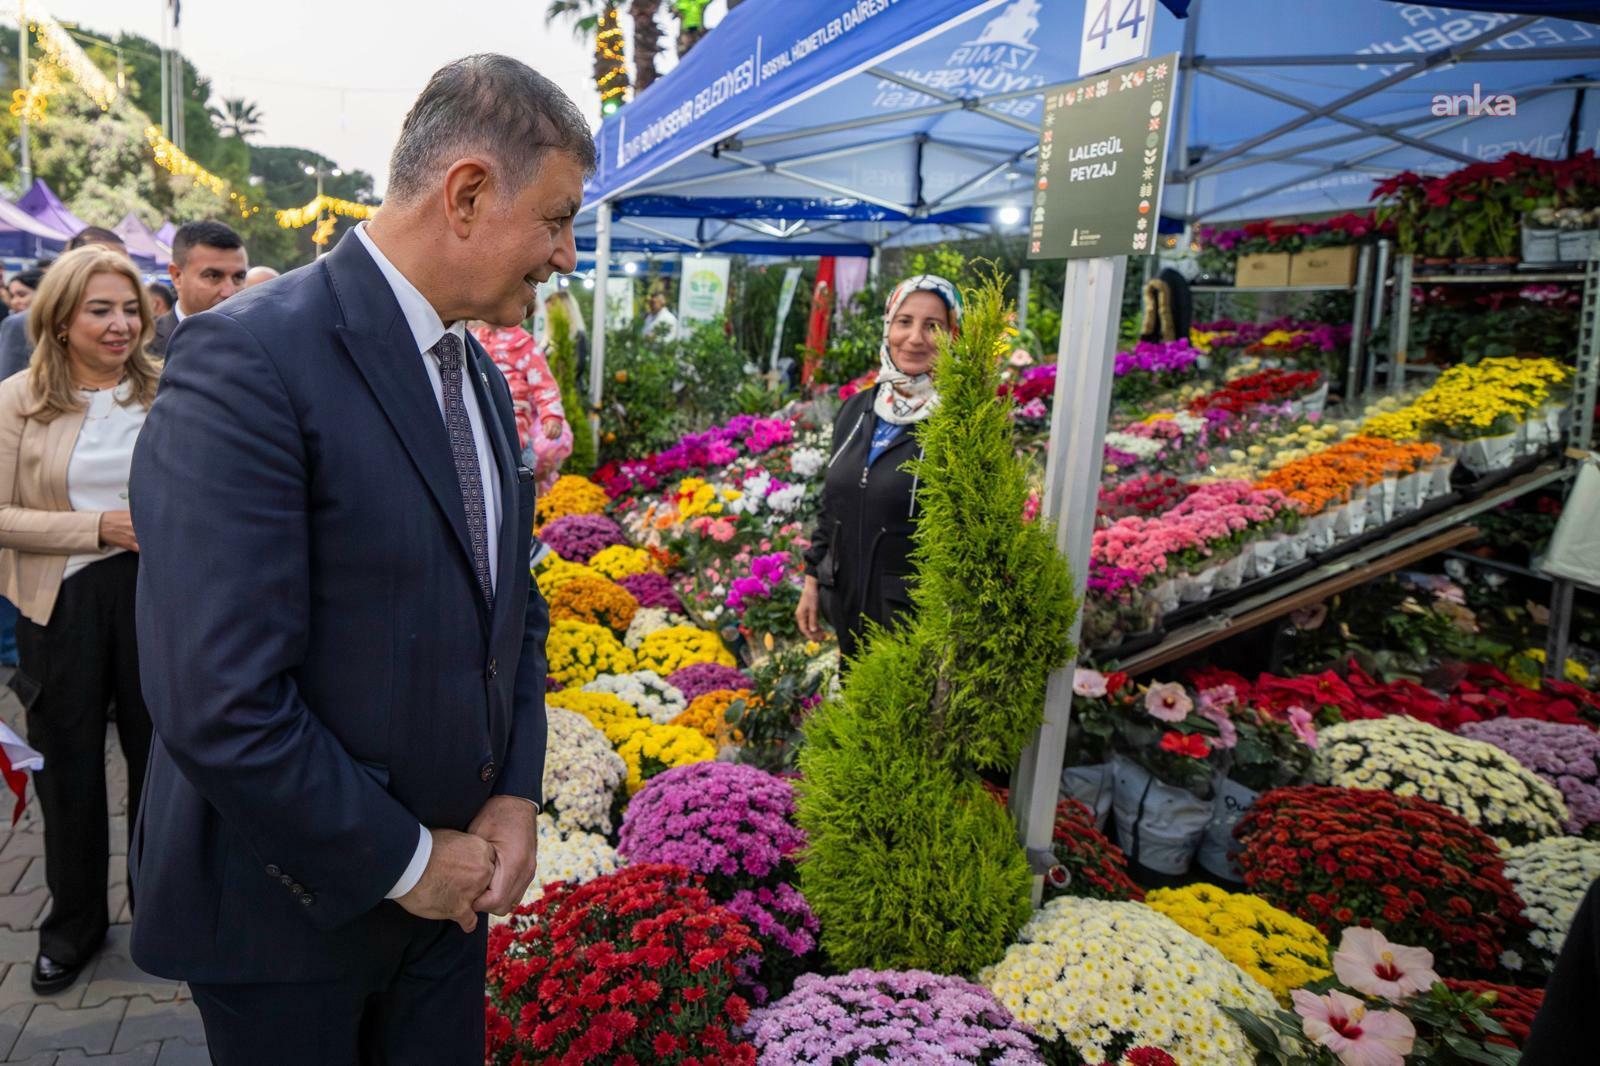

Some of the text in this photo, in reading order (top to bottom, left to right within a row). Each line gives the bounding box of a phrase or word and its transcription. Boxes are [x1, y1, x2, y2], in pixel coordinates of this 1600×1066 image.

[791, 18, 843, 63] HİZMETLER
[1087, 0, 1146, 50] 44
[1068, 135, 1124, 163] LALEGÜL
[1069, 161, 1118, 182] PEYZAJ
